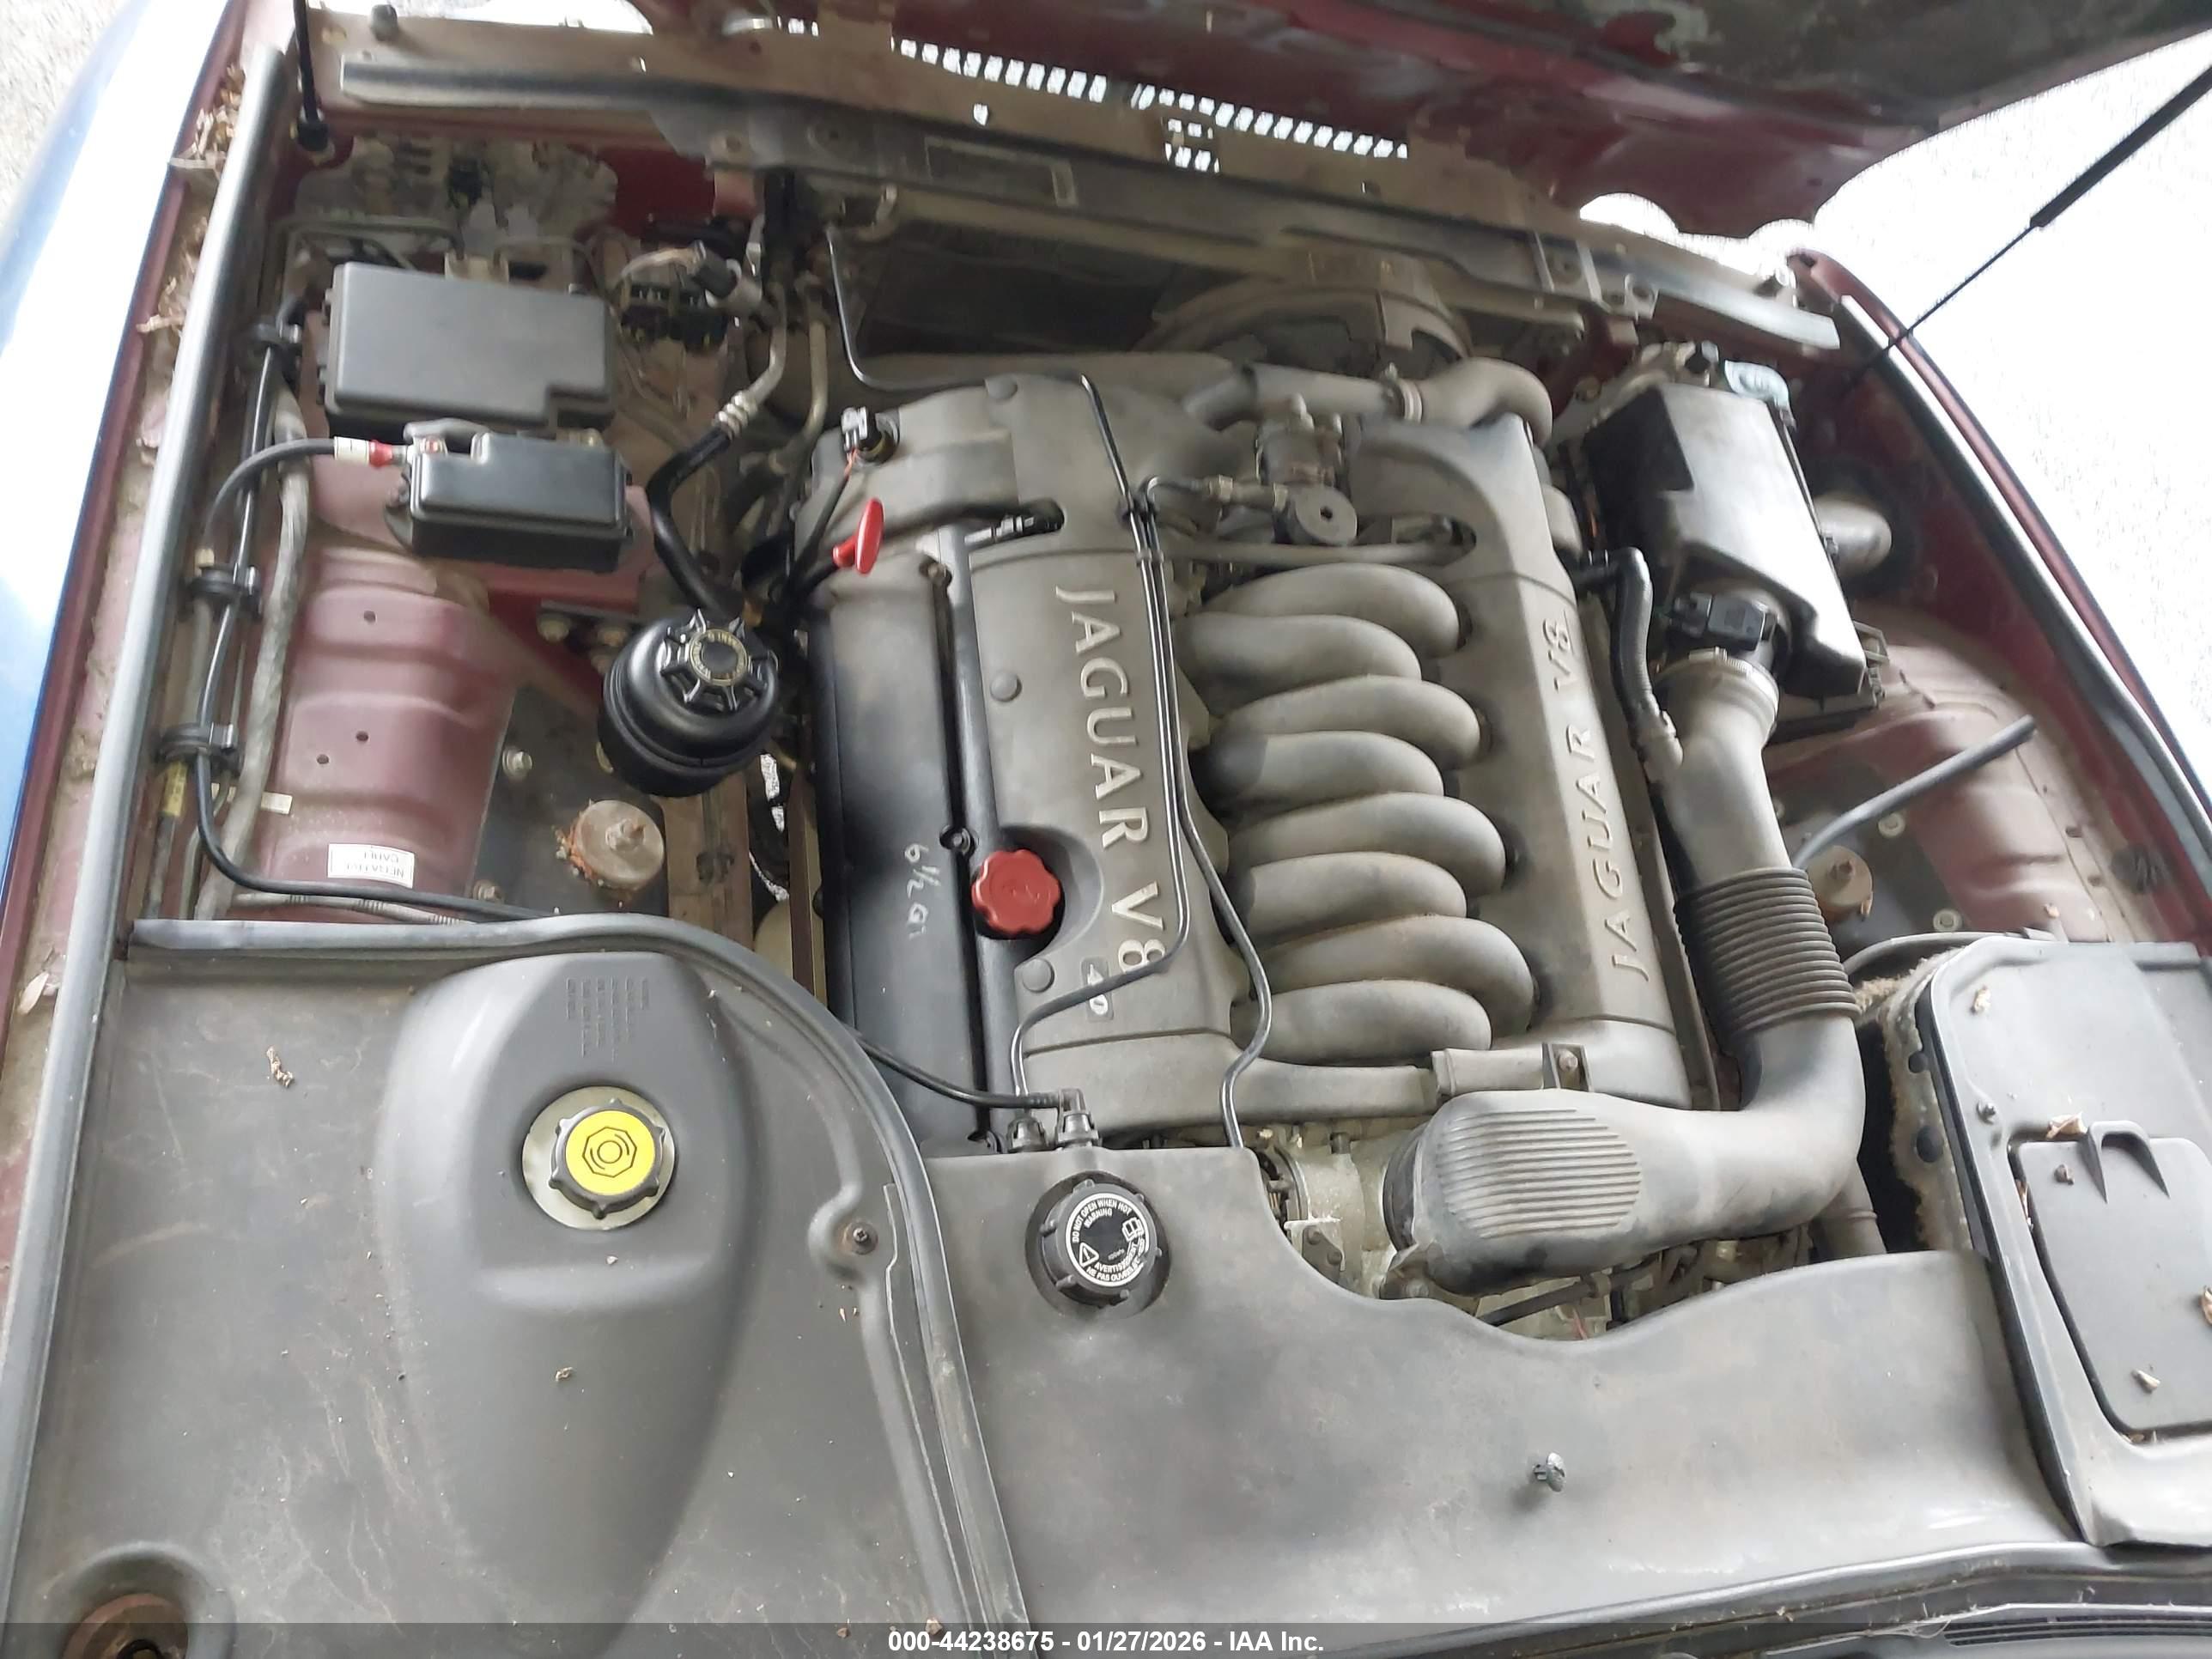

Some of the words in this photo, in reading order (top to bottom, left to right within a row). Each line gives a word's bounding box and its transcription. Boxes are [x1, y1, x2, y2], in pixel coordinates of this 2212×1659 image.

[1542, 616, 1579, 692] V8
[1054, 585, 1150, 849] JAGUAR
[1111, 880, 1166, 974] V8
[1565, 722, 1650, 983] JAGUAR
[1080, 1200, 1098, 1218] OPEN
[1097, 1199, 1117, 1210] WHEN
[1117, 1201, 1133, 1217] HOT
